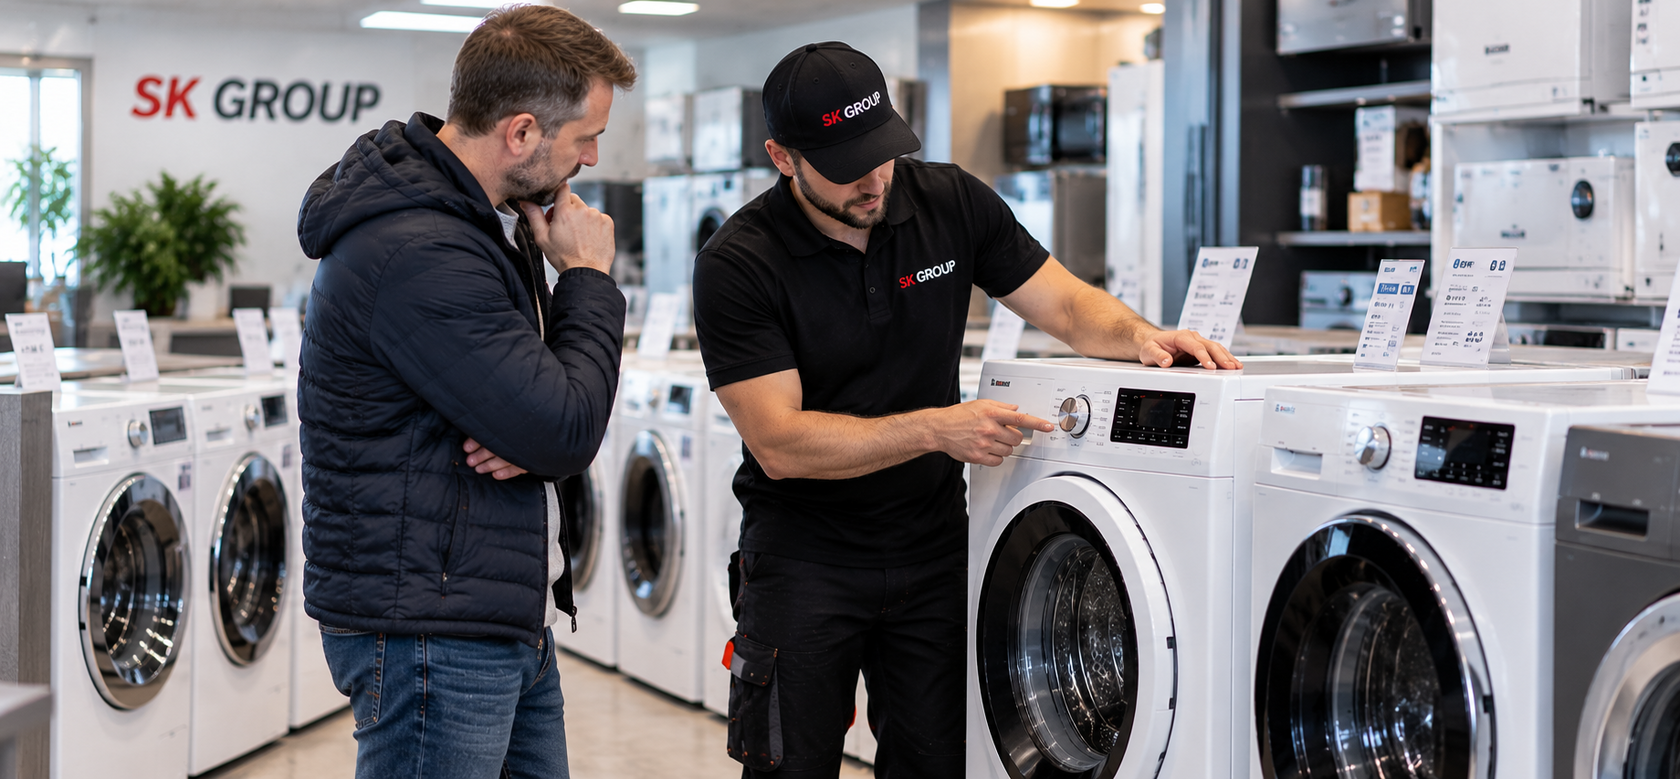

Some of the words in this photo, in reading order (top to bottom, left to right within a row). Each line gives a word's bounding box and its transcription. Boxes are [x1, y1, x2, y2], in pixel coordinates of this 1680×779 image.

[131, 75, 200, 119] SK
[214, 78, 381, 122] GROUP
[822, 109, 843, 127] SK
[844, 91, 881, 119] GROUP
[899, 273, 916, 289] SK
[916, 259, 956, 283] GROUP
